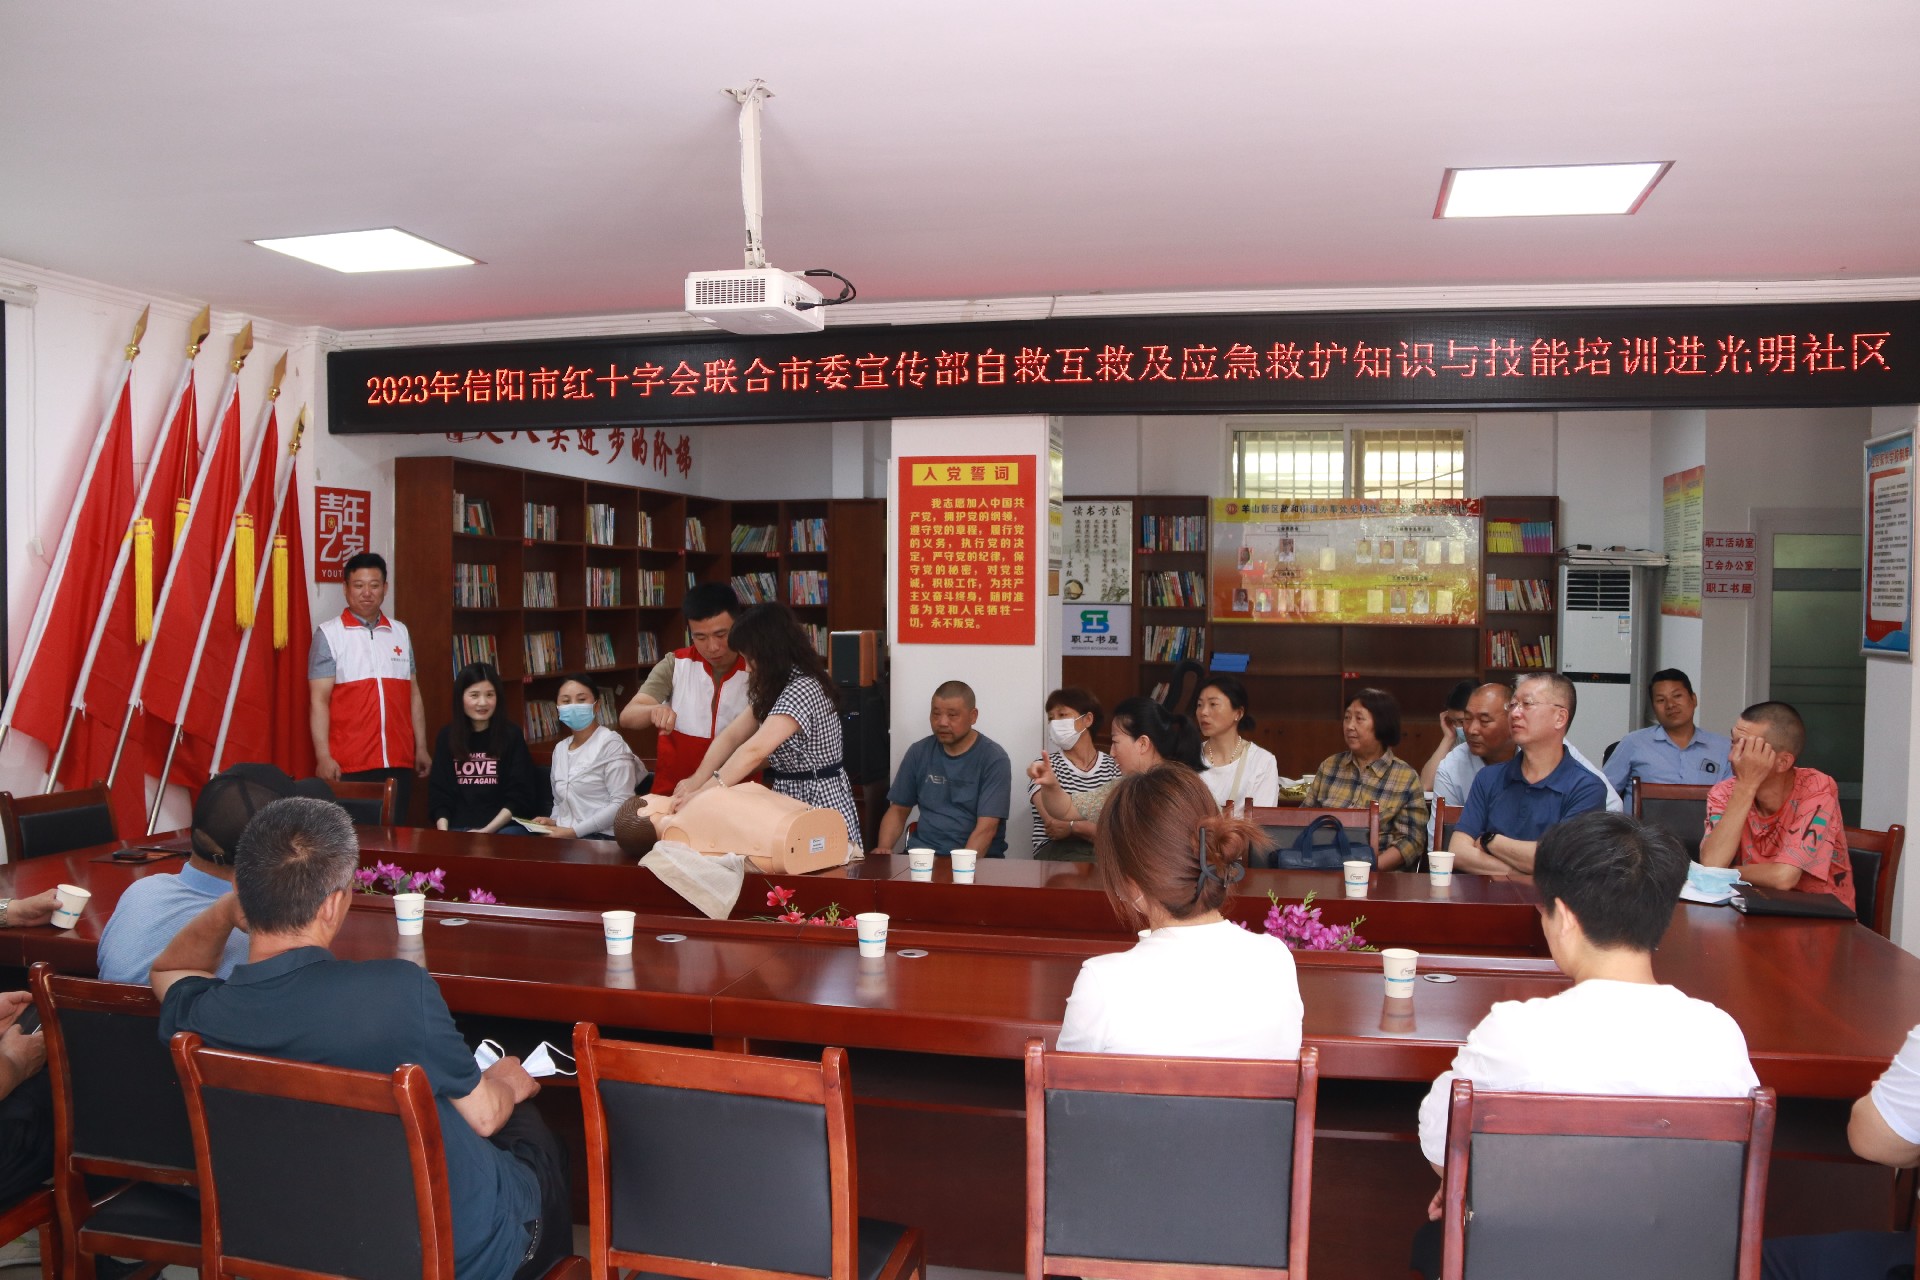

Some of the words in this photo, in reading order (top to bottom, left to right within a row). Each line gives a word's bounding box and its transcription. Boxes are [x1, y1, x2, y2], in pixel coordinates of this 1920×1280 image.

[366, 331, 1892, 405] 2023年信阳市红十字会联合市委宣传部自救互救及应急救护知识与技能培训进光明社区
[446, 427, 692, 480] 类进步的阶梯
[922, 465, 1010, 482] 入党誓词
[931, 498, 1025, 509] 我志愿加入中国共
[319, 492, 365, 535] 青年
[1073, 505, 1121, 516] 读书方法
[1705, 537, 1754, 549] 职工活动室
[1705, 560, 1754, 571] 工会办公室
[321, 569, 343, 578] YOUT
[1706, 583, 1752, 594] 职工书屋
[1071, 635, 1119, 645] 职工书屋
[454, 761, 497, 775] LOVE
